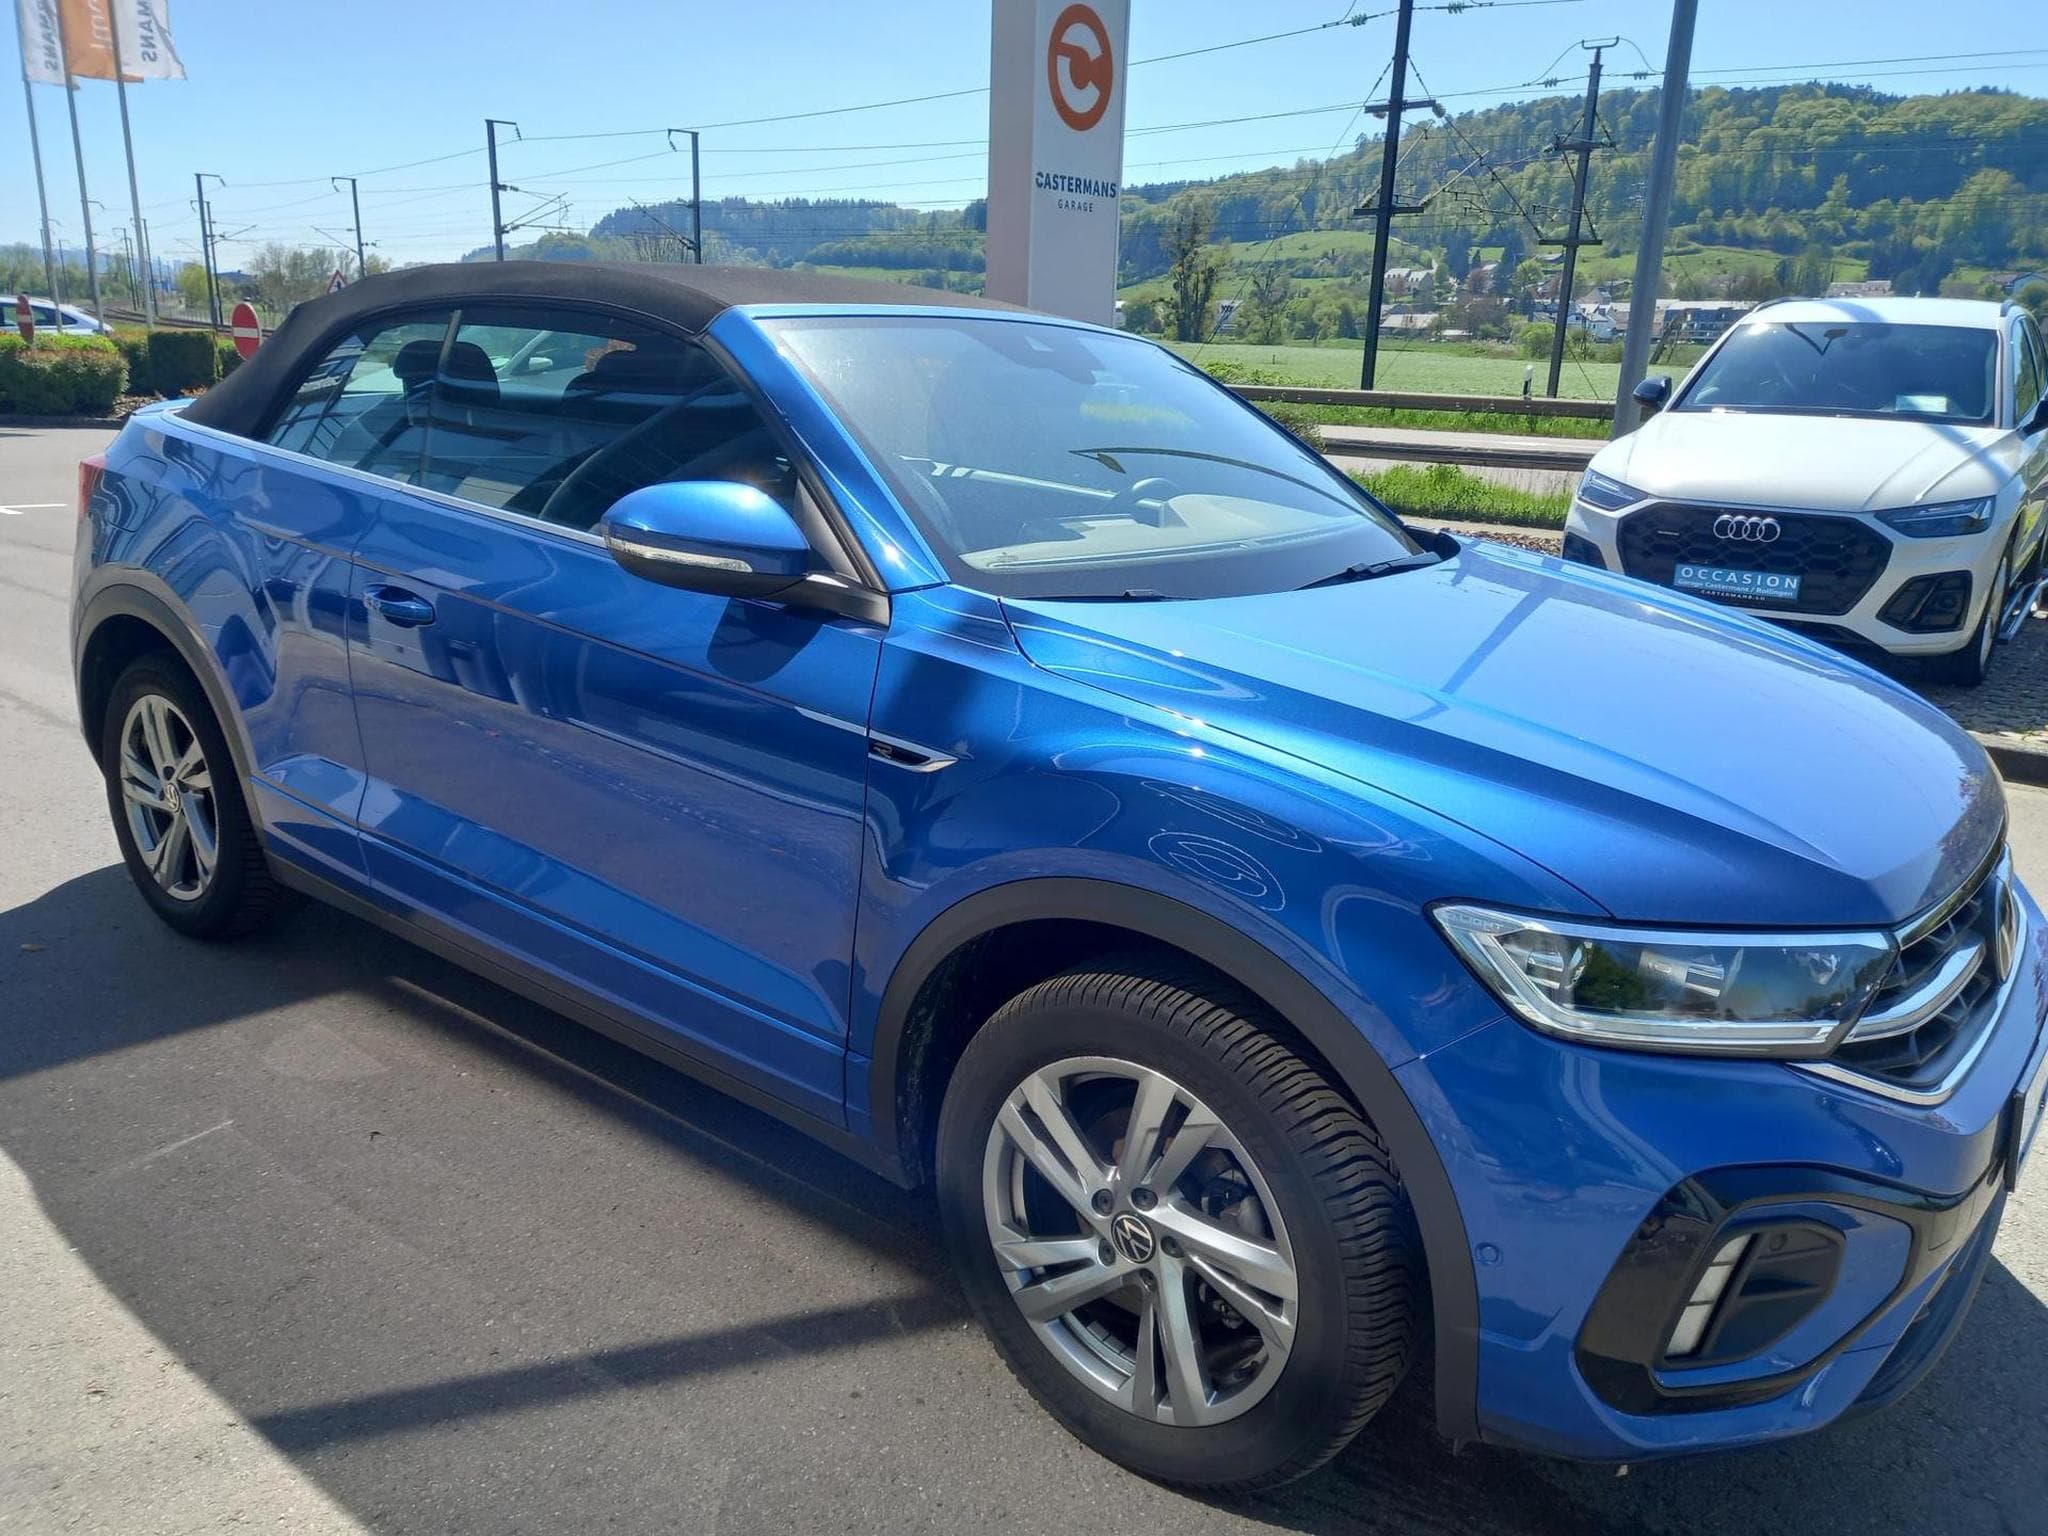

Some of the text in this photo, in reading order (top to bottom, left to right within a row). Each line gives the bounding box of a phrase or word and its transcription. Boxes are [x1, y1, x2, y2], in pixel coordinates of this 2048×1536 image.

[1035, 171, 1117, 199] CASTERMANS
[1058, 199, 1094, 213] GARAGE
[1680, 567, 1798, 589] OCCASION
